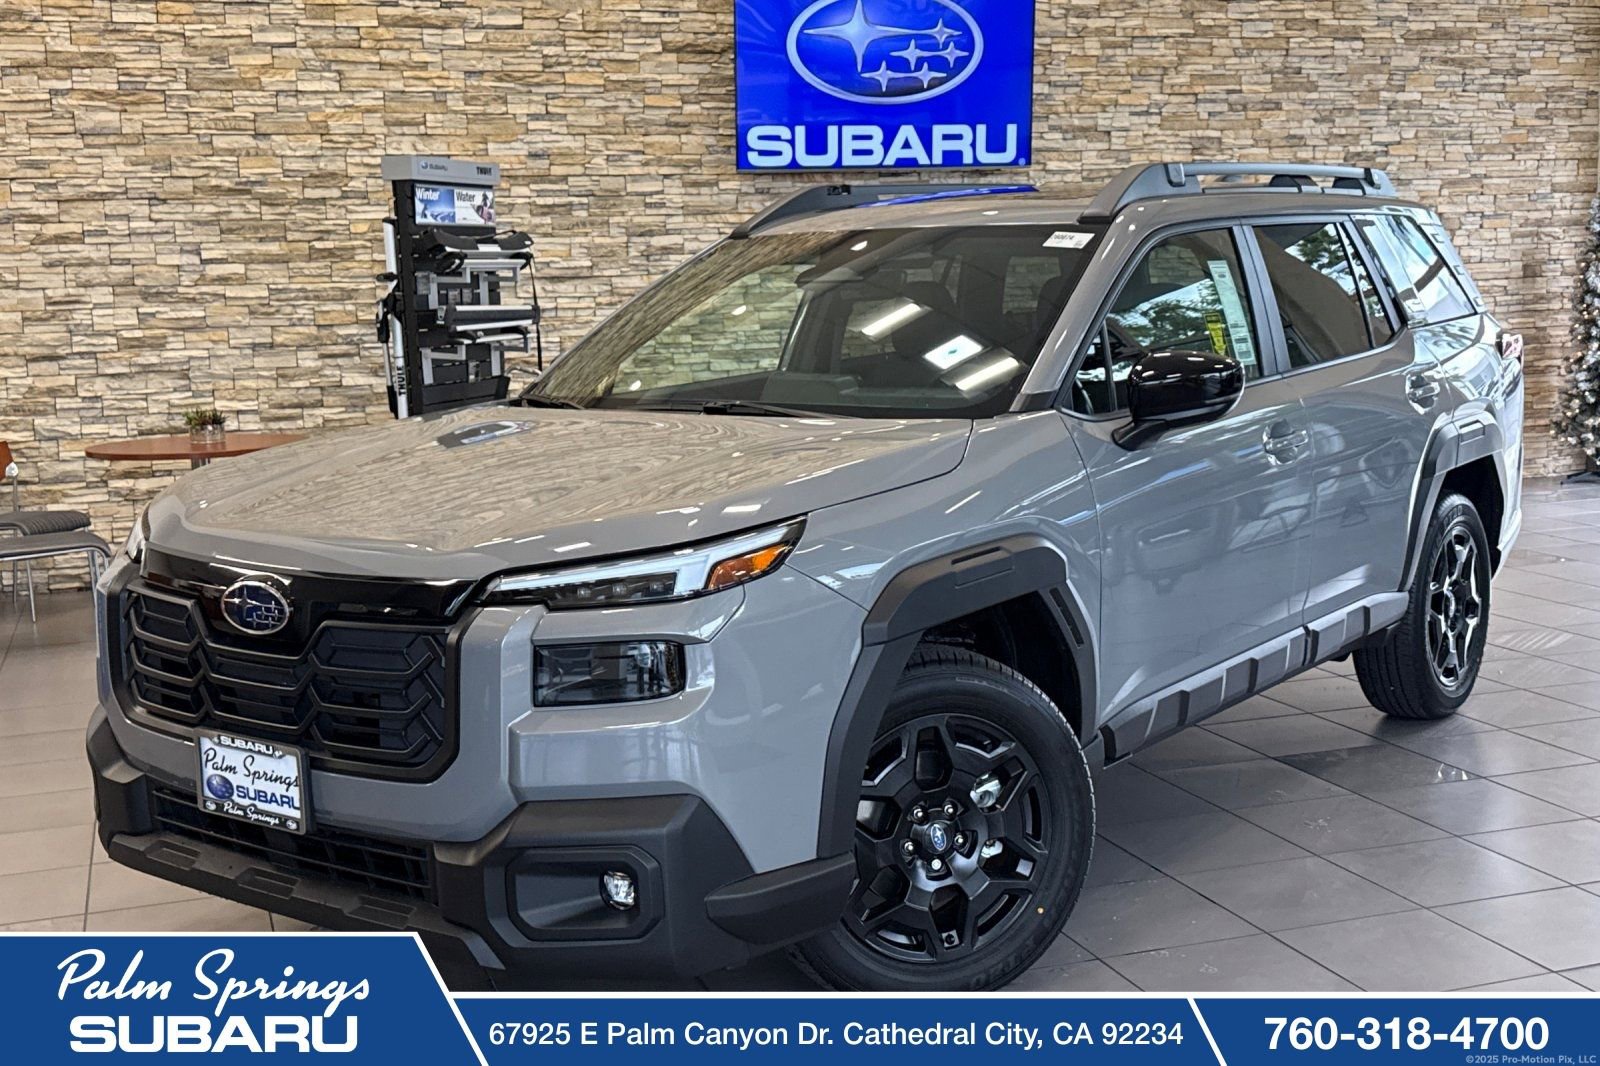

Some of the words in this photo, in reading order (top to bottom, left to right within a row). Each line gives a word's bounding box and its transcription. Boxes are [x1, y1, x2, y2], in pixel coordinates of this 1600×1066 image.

[746, 123, 1018, 167] SUBARU
[415, 187, 440, 201] Winter
[456, 191, 476, 202] Water
[396, 365, 406, 397] THULE
[219, 735, 273, 754] SUBARU
[204, 747, 238, 775] Palm
[243, 755, 299, 793] Springs
[223, 801, 244, 816] Palm
[246, 806, 280, 826] Springs
